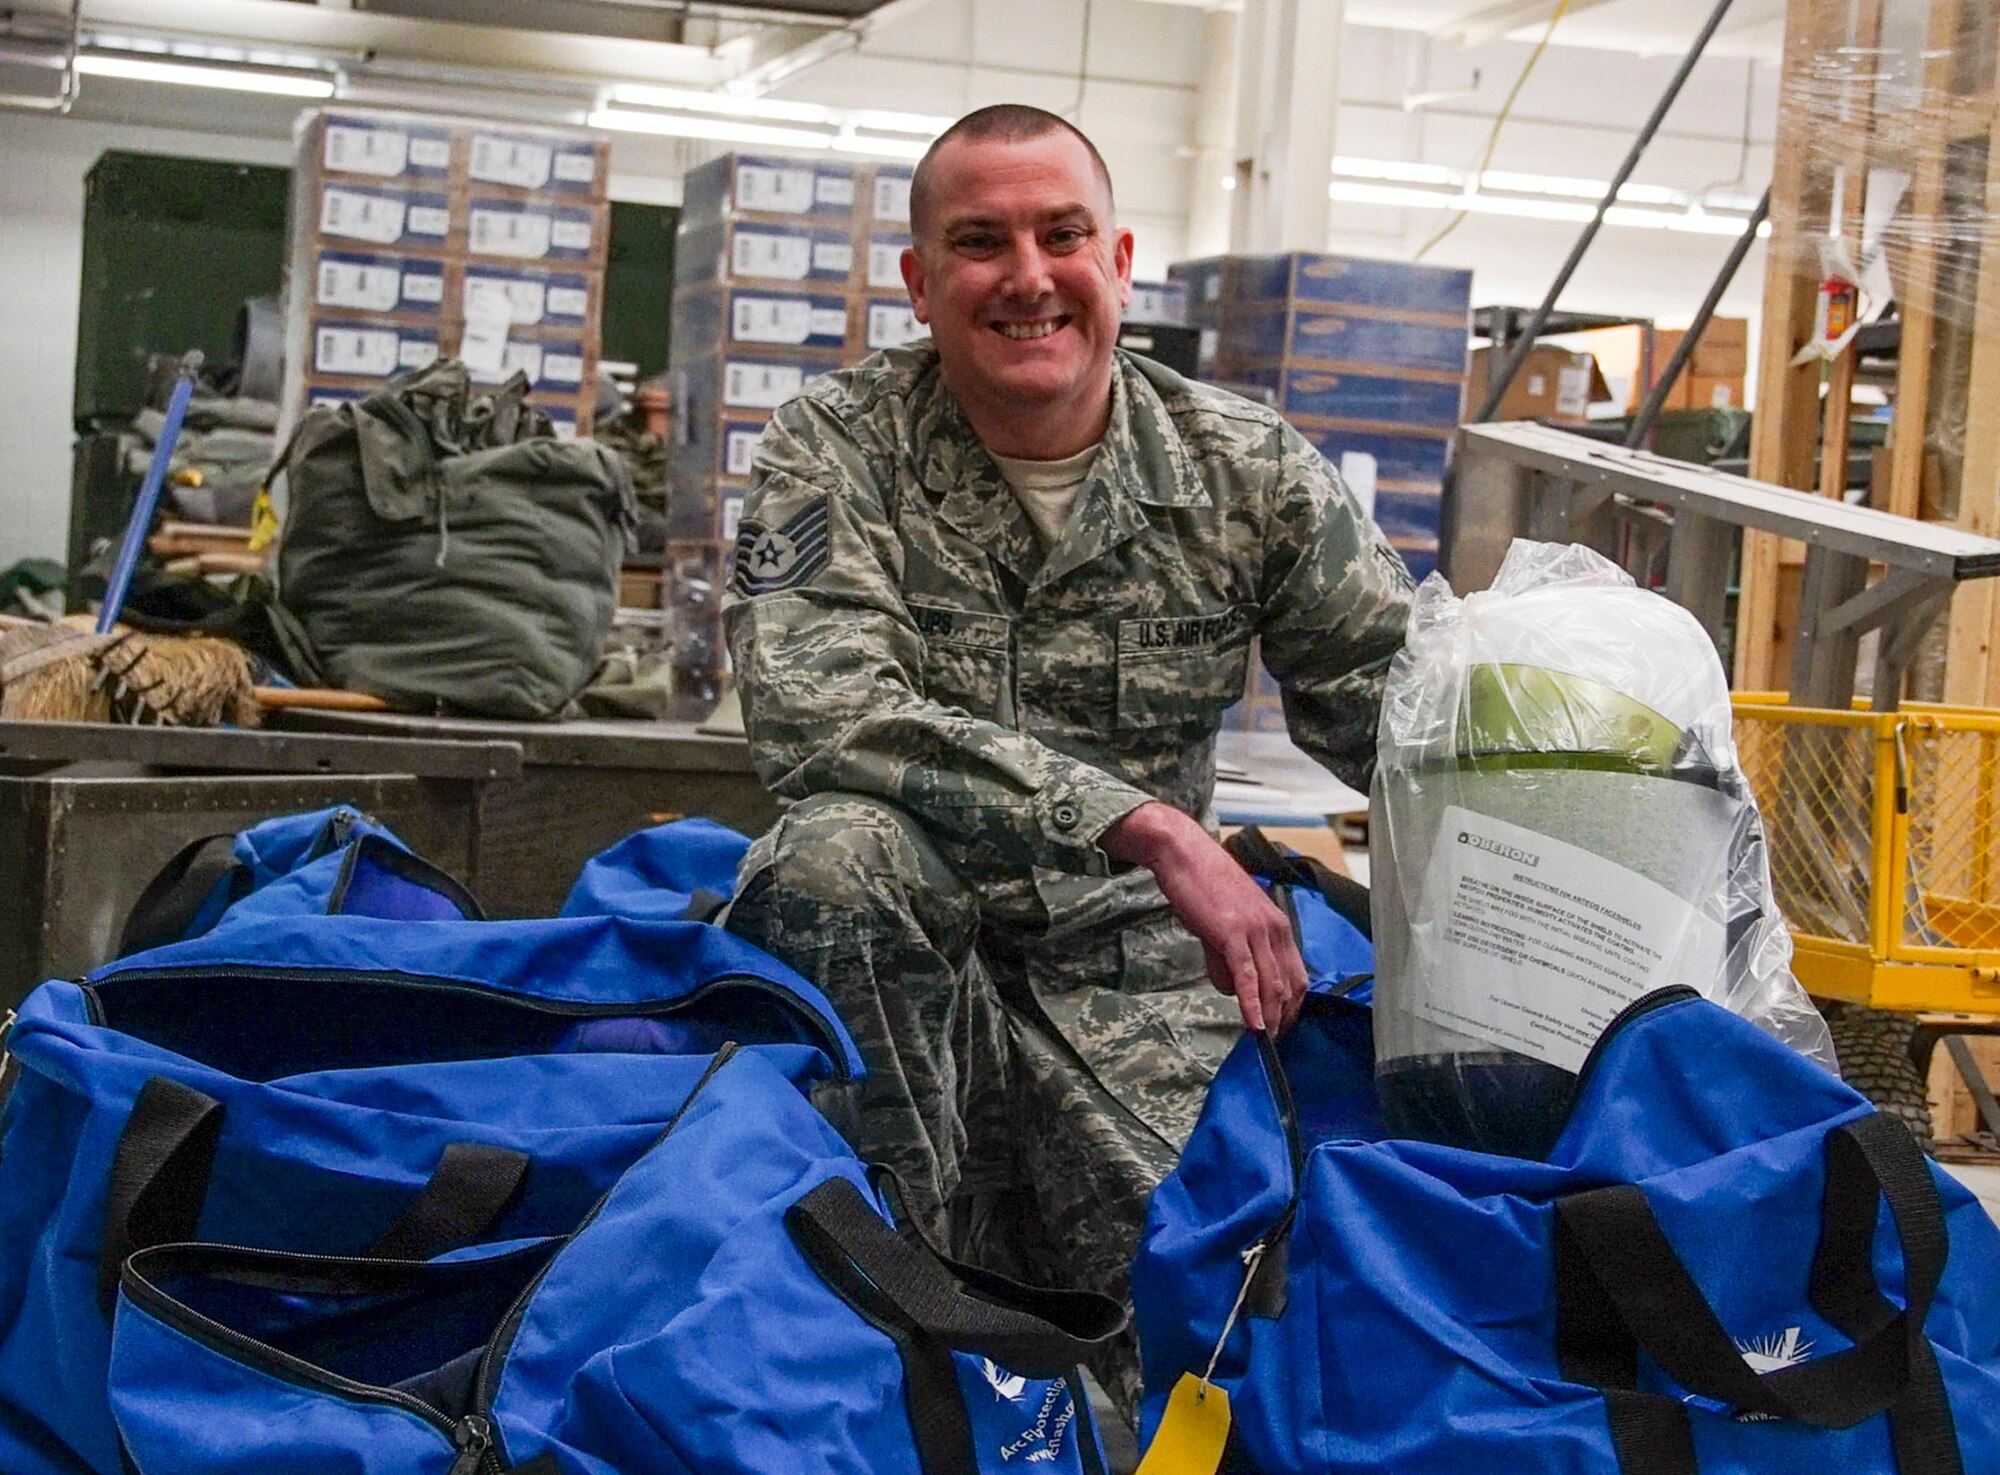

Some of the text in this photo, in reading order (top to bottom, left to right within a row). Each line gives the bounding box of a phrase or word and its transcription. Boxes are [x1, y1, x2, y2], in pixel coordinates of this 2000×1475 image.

[1139, 621, 1170, 648] U.S.
[1173, 620, 1200, 646] AIR
[1468, 835, 1538, 866] OBERON
[1513, 873, 1559, 895] INSTRUCTIONS
[1489, 884, 1499, 893] ON
[1501, 888, 1513, 898] THE
[1535, 901, 1565, 916] SURFACE
[1566, 911, 1576, 920] OF
[1577, 915, 1589, 925] THE
[1590, 922, 1613, 936] SHIELD
[1594, 931, 1606, 942] THE
[1001, 1440, 1027, 1461] Arc
